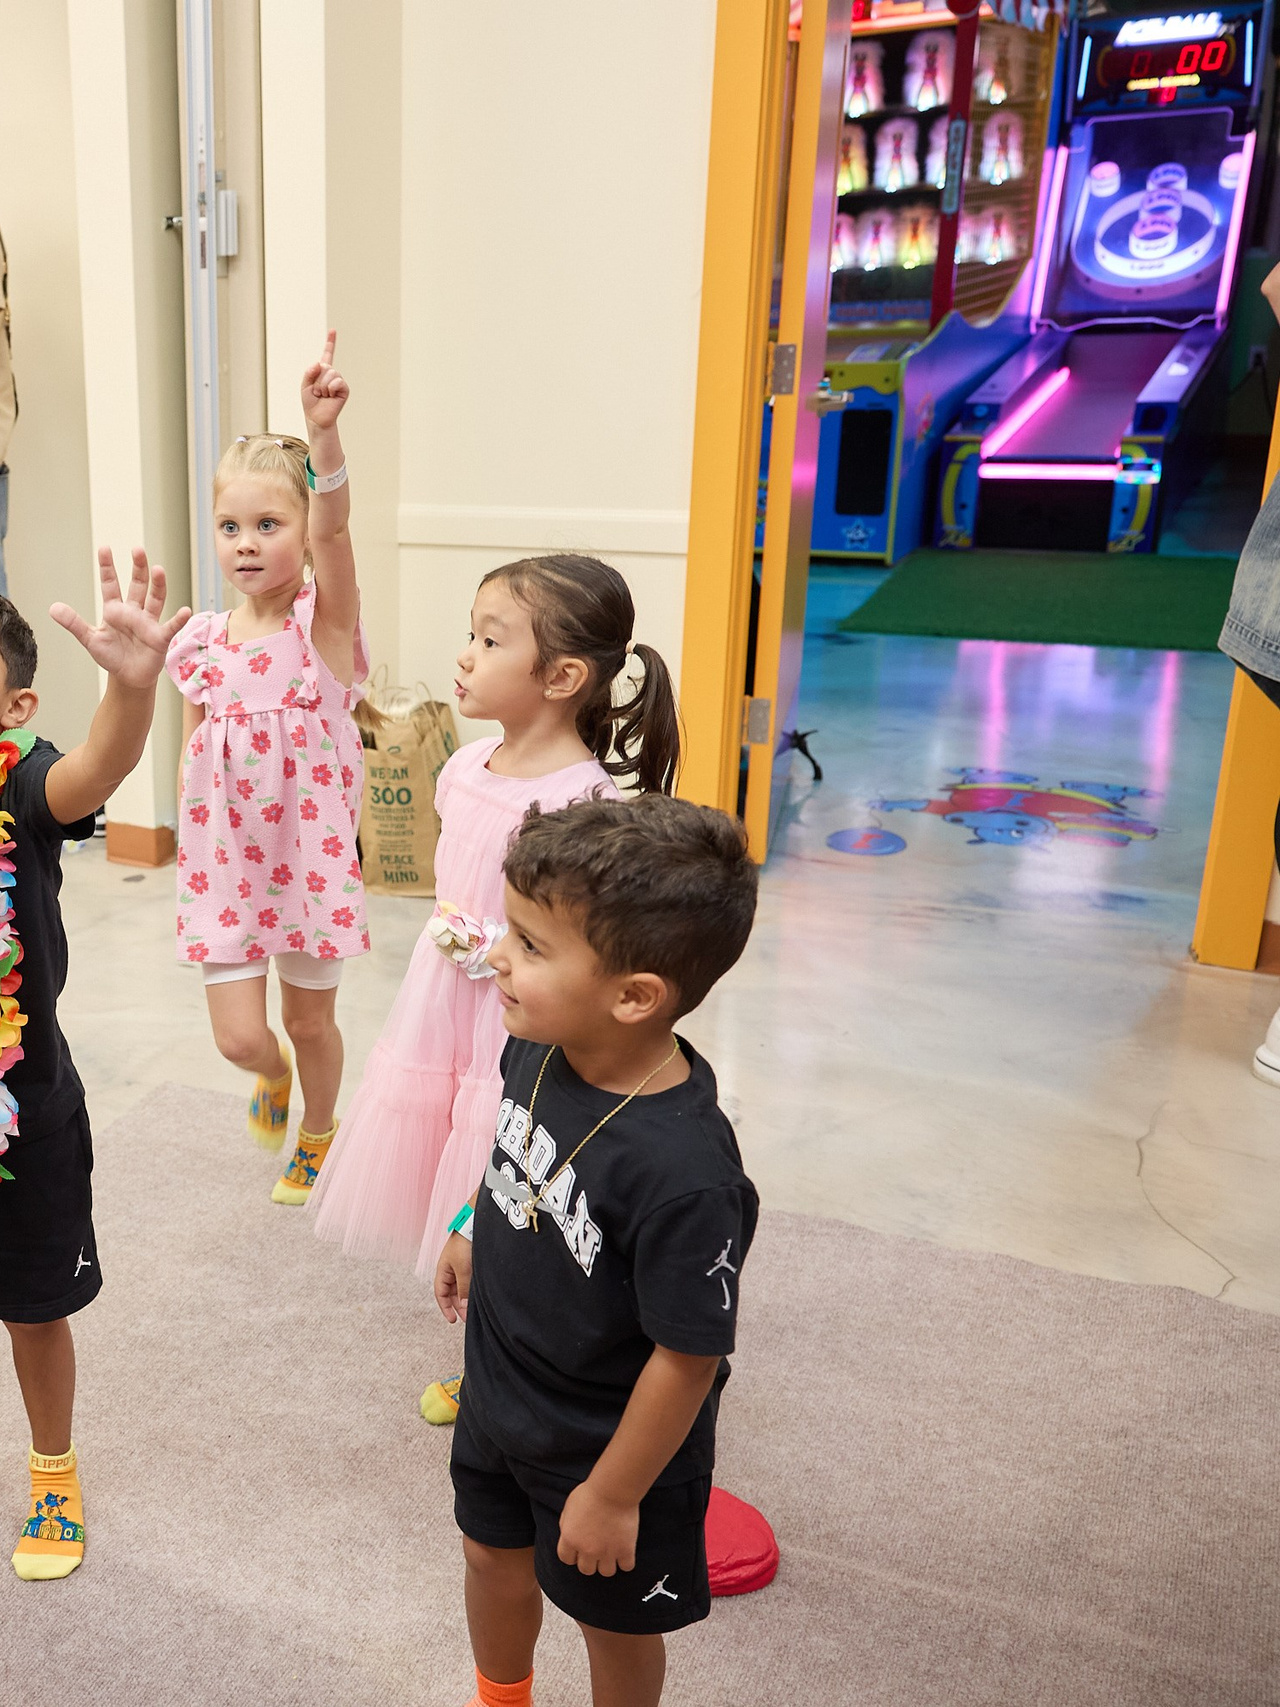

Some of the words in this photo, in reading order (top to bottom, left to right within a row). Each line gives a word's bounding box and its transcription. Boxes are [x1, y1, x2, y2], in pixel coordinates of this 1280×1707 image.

[370, 786, 413, 805] 300
[379, 854, 415, 866] PEACE
[383, 870, 419, 884] MIND
[496, 1097, 604, 1278] ORDAN
